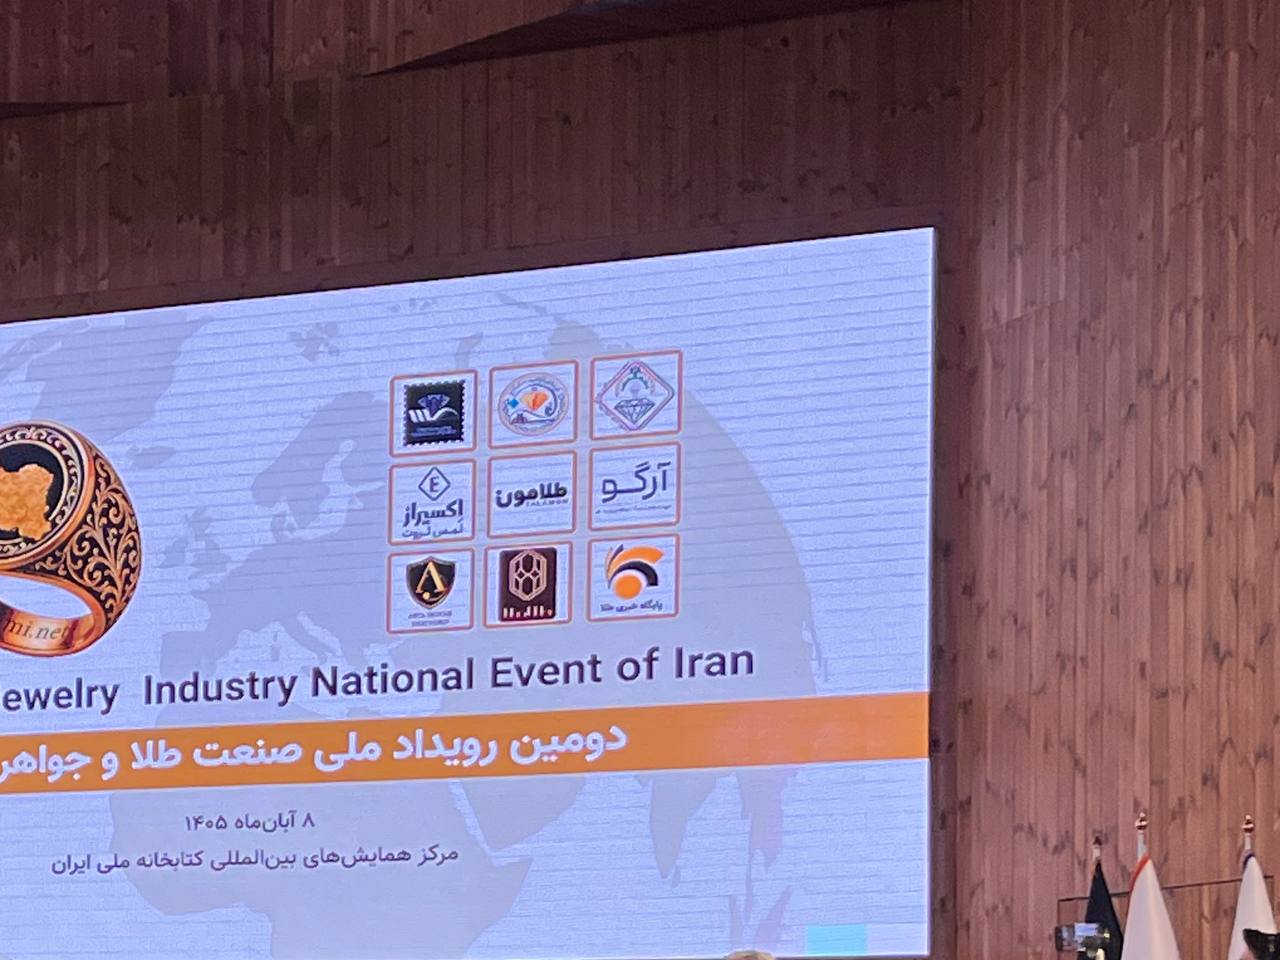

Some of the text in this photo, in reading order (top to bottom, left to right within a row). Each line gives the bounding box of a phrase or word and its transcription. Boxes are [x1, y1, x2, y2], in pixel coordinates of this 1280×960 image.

[144, 671, 298, 707] Industry
[311, 657, 474, 698] National
[490, 653, 602, 689] Event
[616, 646, 659, 682] of
[674, 646, 755, 680] Iran
[130, 740, 182, 770] طلا
[193, 737, 302, 768] صنعت
[314, 731, 382, 772] ملی
[393, 728, 498, 767] رویداد
[510, 724, 627, 765] دومین
[100, 753, 120, 781] و
[185, 815, 228, 832] ۱۴۰۵
[302, 812, 315, 829] ۸
[51, 853, 91, 876] ایران
[97, 853, 130, 875] ملی
[137, 850, 204, 872] کتابخانه
[417, 844, 459, 867] مرکز
